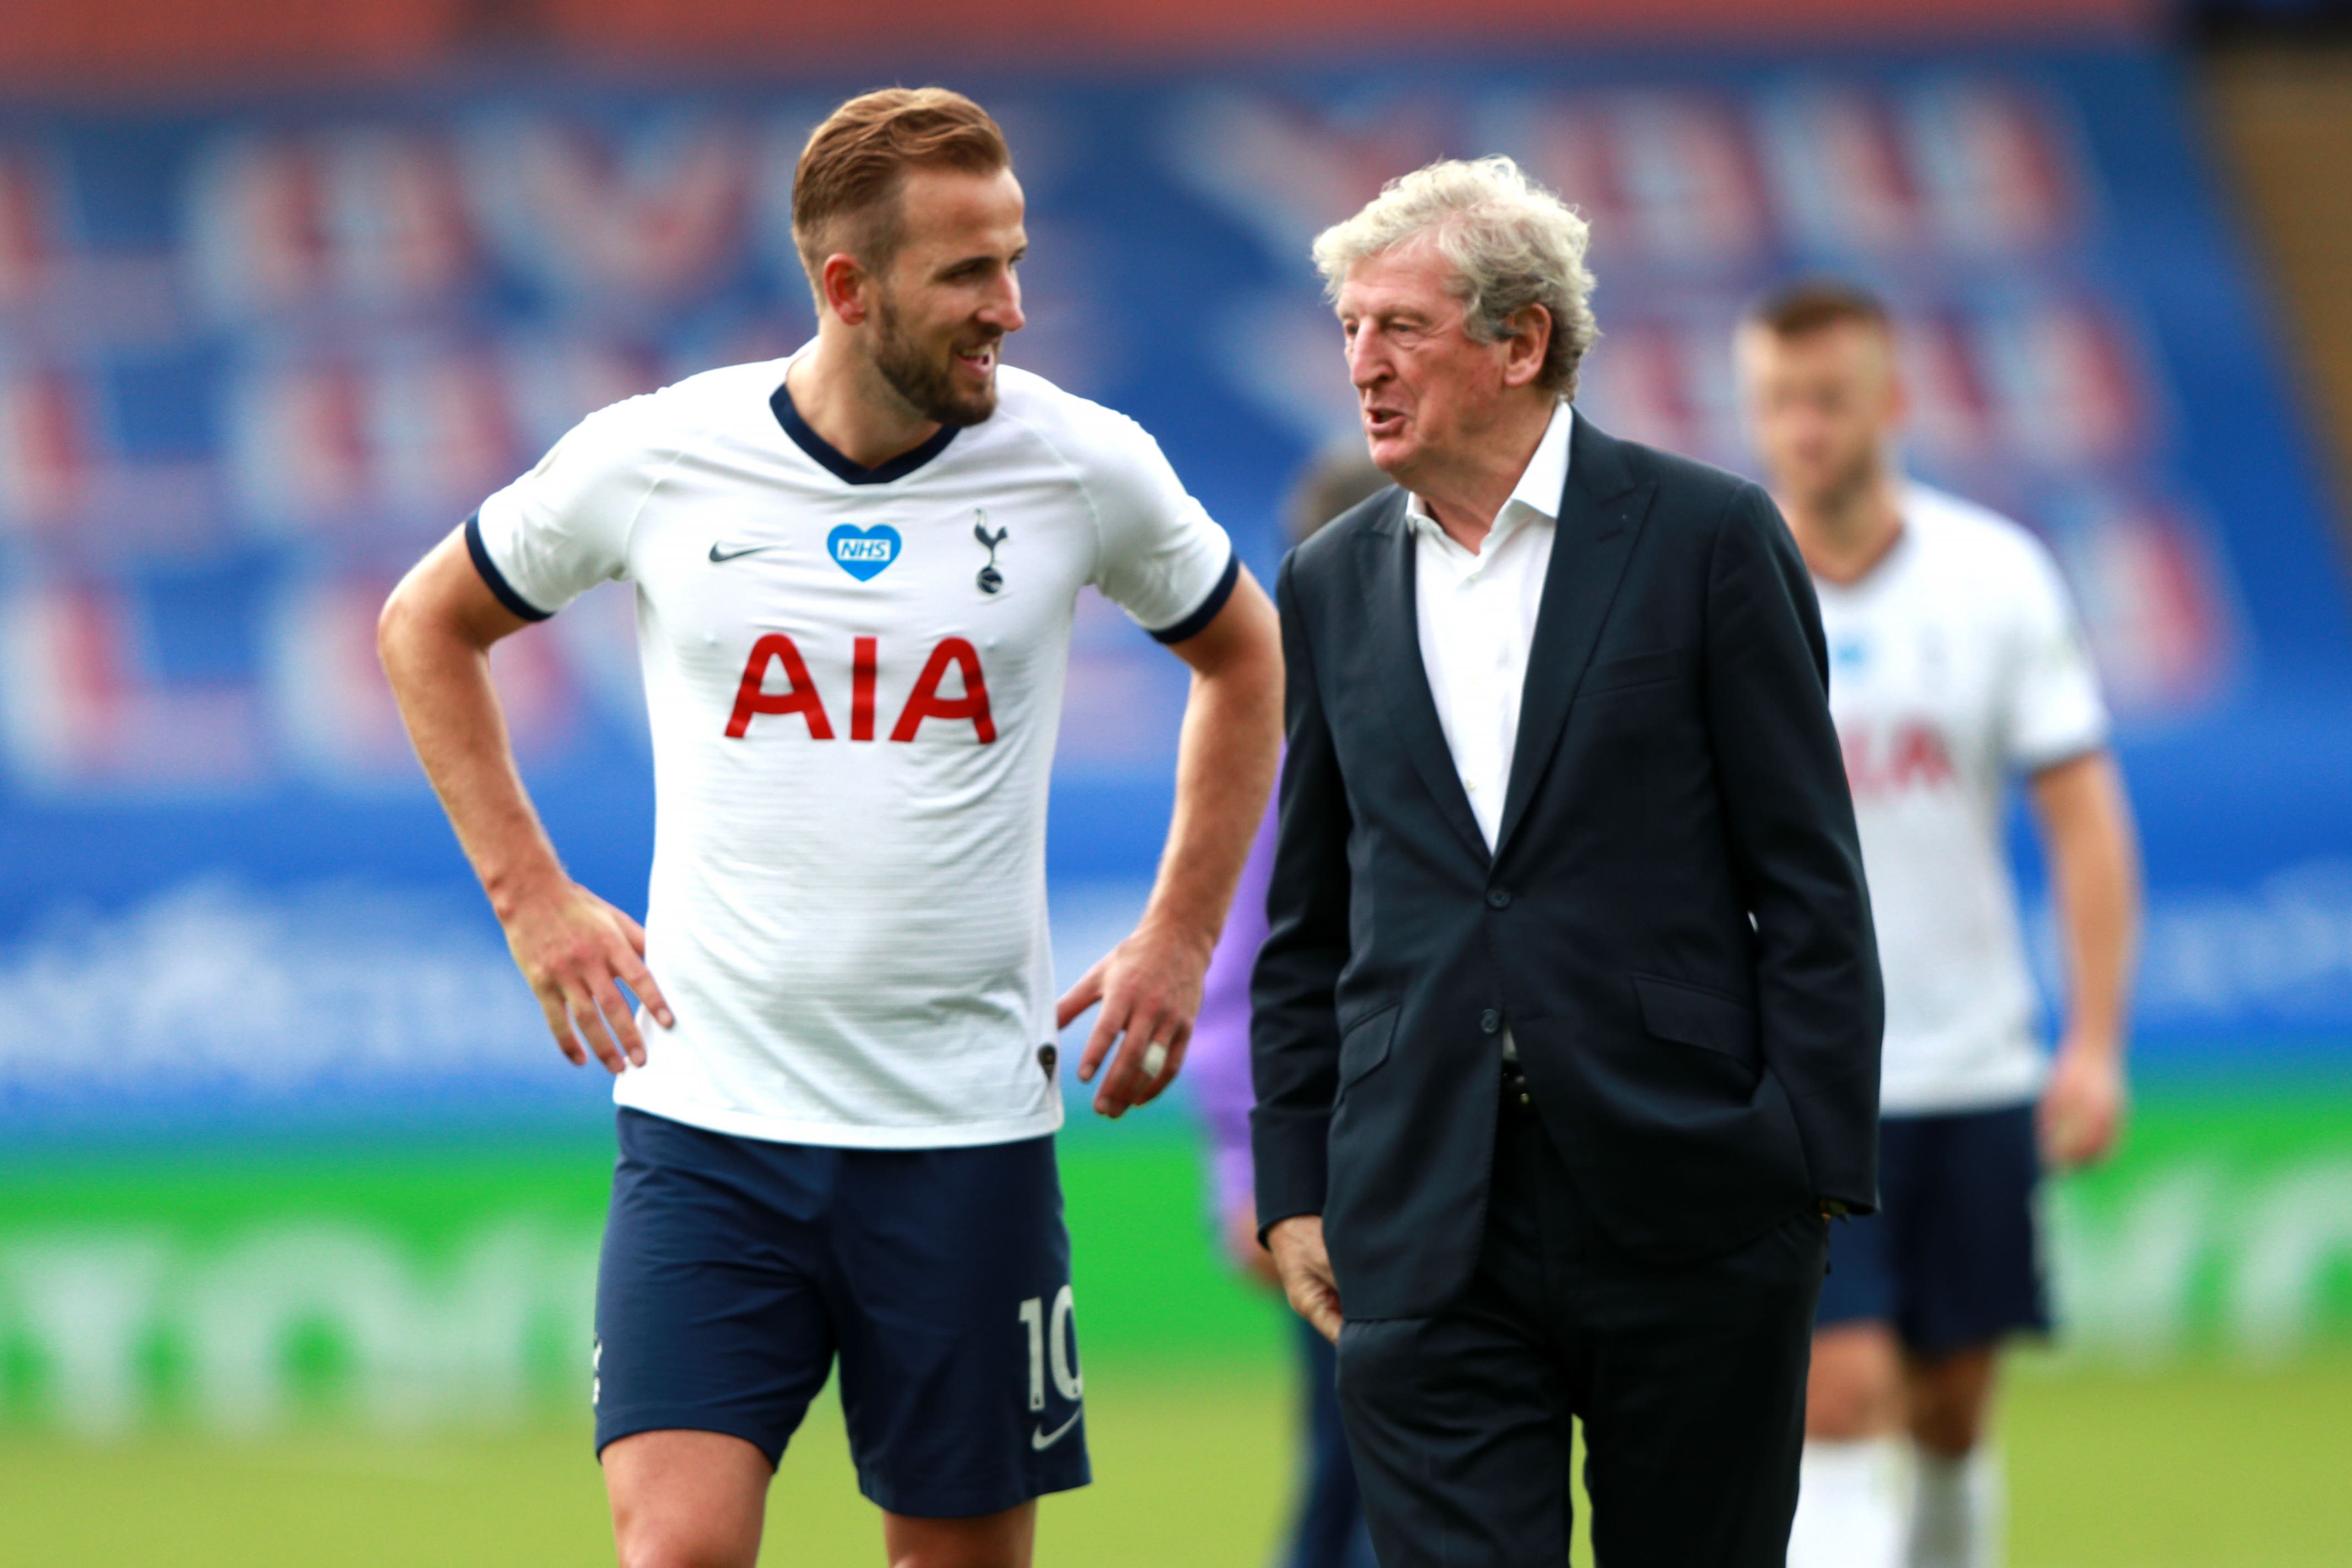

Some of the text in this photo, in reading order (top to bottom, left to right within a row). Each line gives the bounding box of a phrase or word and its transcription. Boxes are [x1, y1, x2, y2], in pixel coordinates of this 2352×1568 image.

[841, 542, 886, 557] NHS
[725, 633, 997, 744] AIA
[1019, 1284, 1083, 1411] 10
